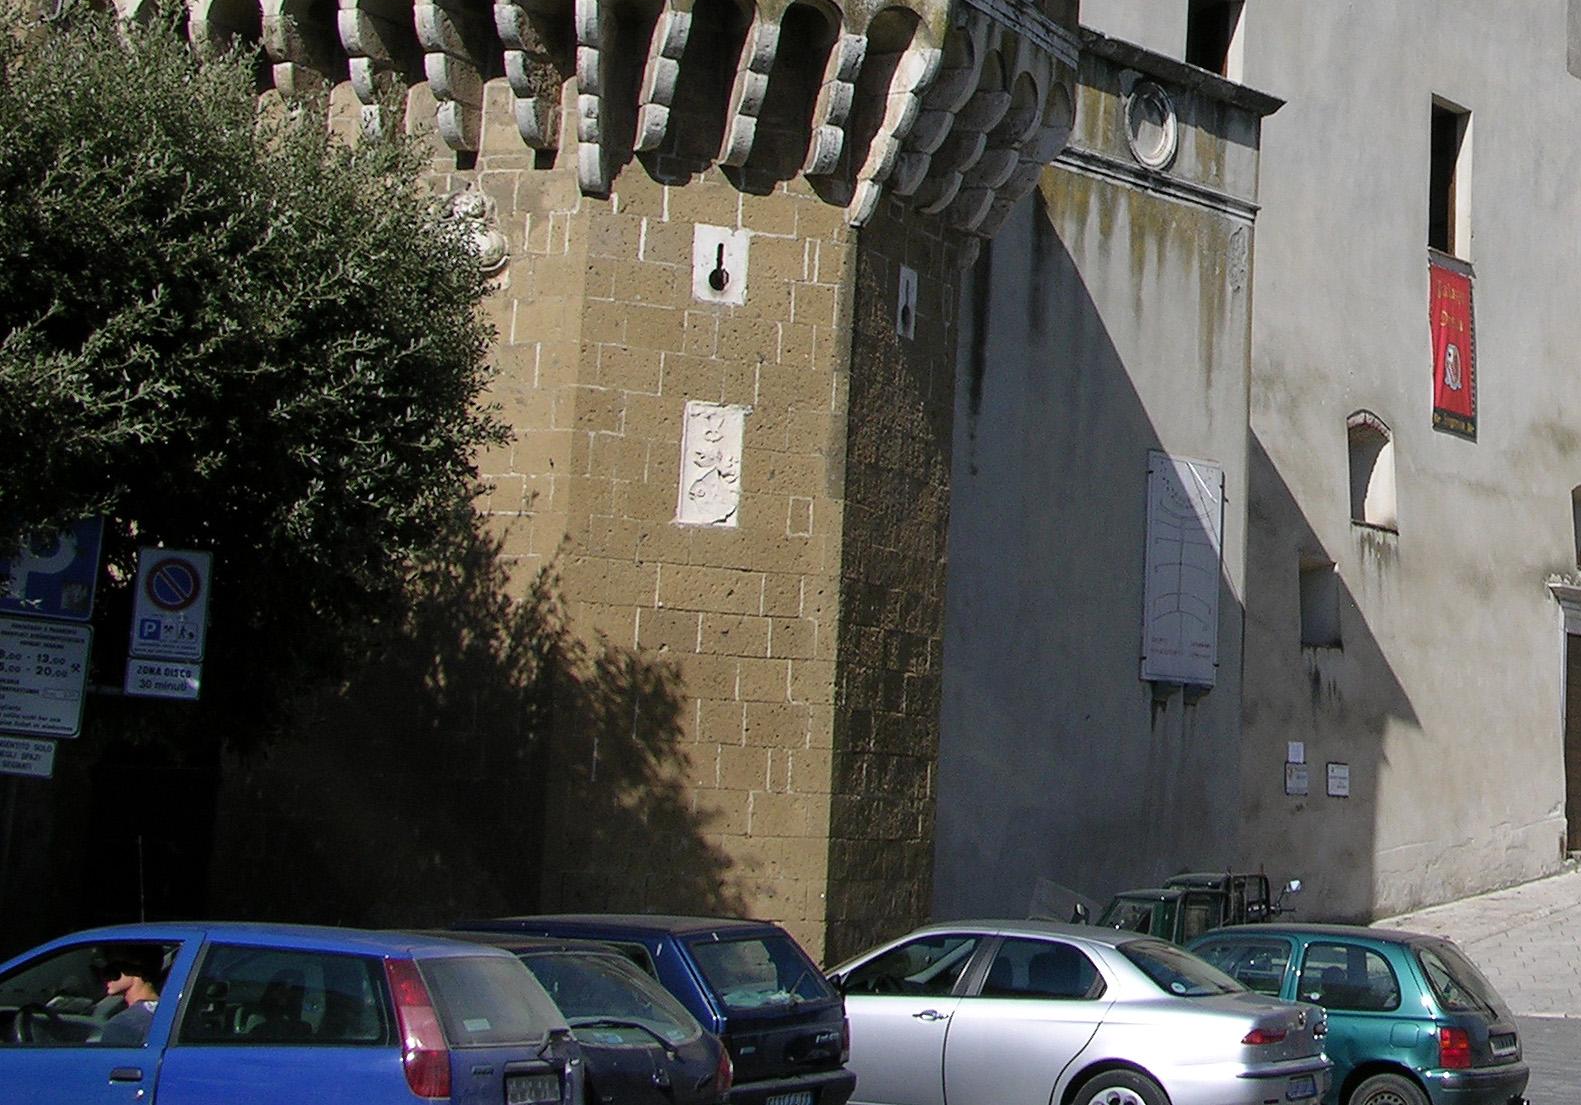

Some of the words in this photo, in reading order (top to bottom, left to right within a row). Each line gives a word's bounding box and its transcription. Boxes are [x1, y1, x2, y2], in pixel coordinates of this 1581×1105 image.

[144, 621, 157, 636] P
[137, 665, 161, 676] ZONA
[164, 668, 191, 678] DISCO
[138, 679, 152, 688] 30
